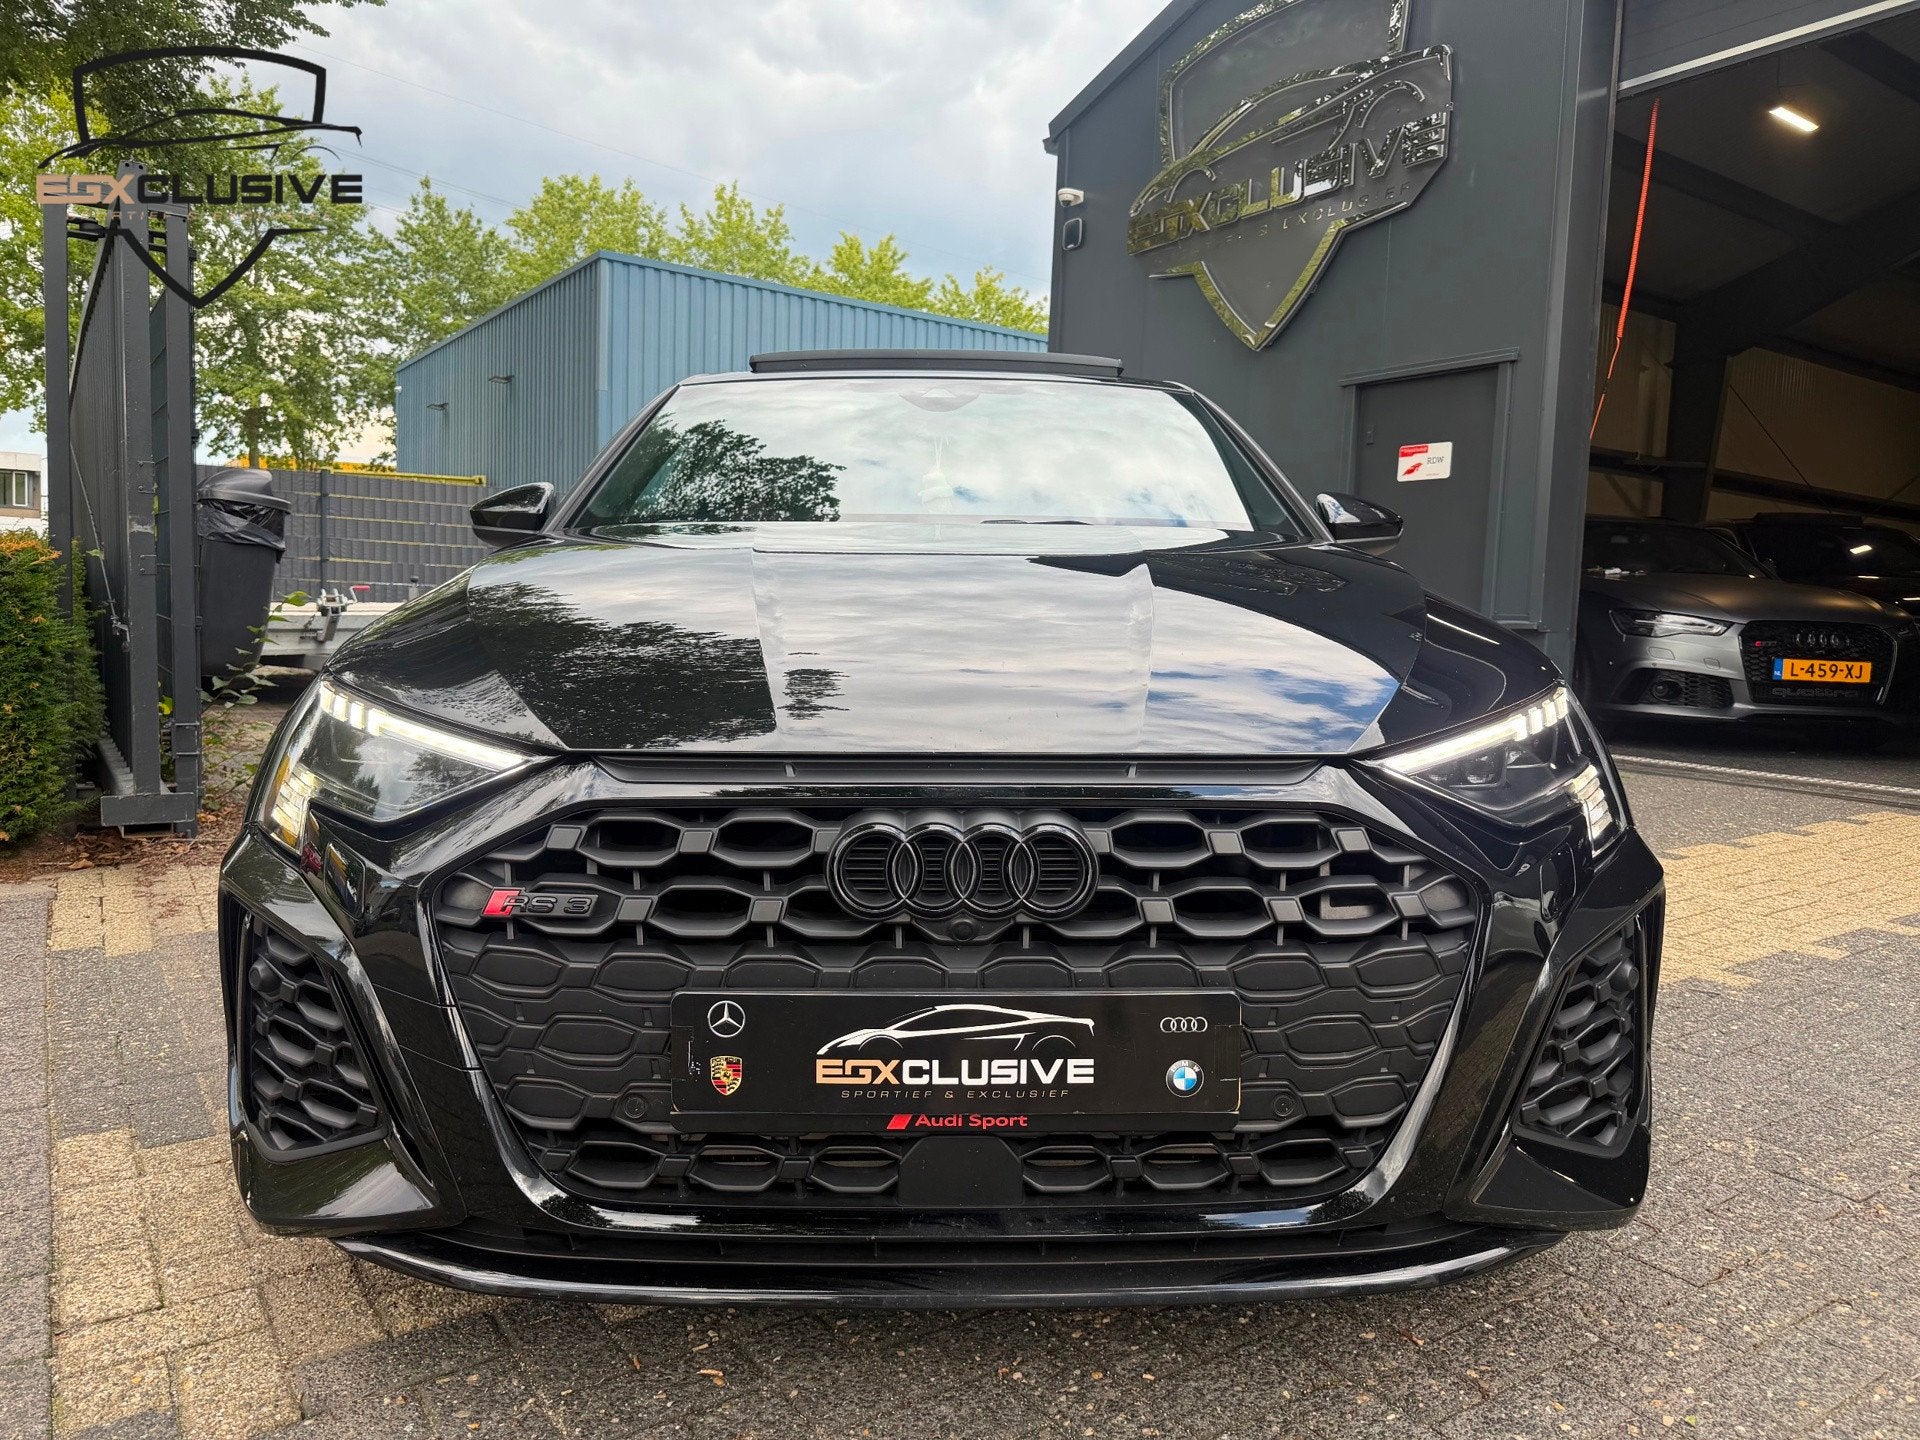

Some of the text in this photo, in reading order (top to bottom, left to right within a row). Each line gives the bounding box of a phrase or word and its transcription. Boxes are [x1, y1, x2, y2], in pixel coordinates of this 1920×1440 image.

[1790, 662, 1863, 680] L-459-XJ
[815, 1058, 1094, 1086] EGXCLUSIVE
[841, 1089, 1069, 1099] SPORTIEF & EXCLUSIEF
[914, 1113, 1028, 1130] Audi Sport
